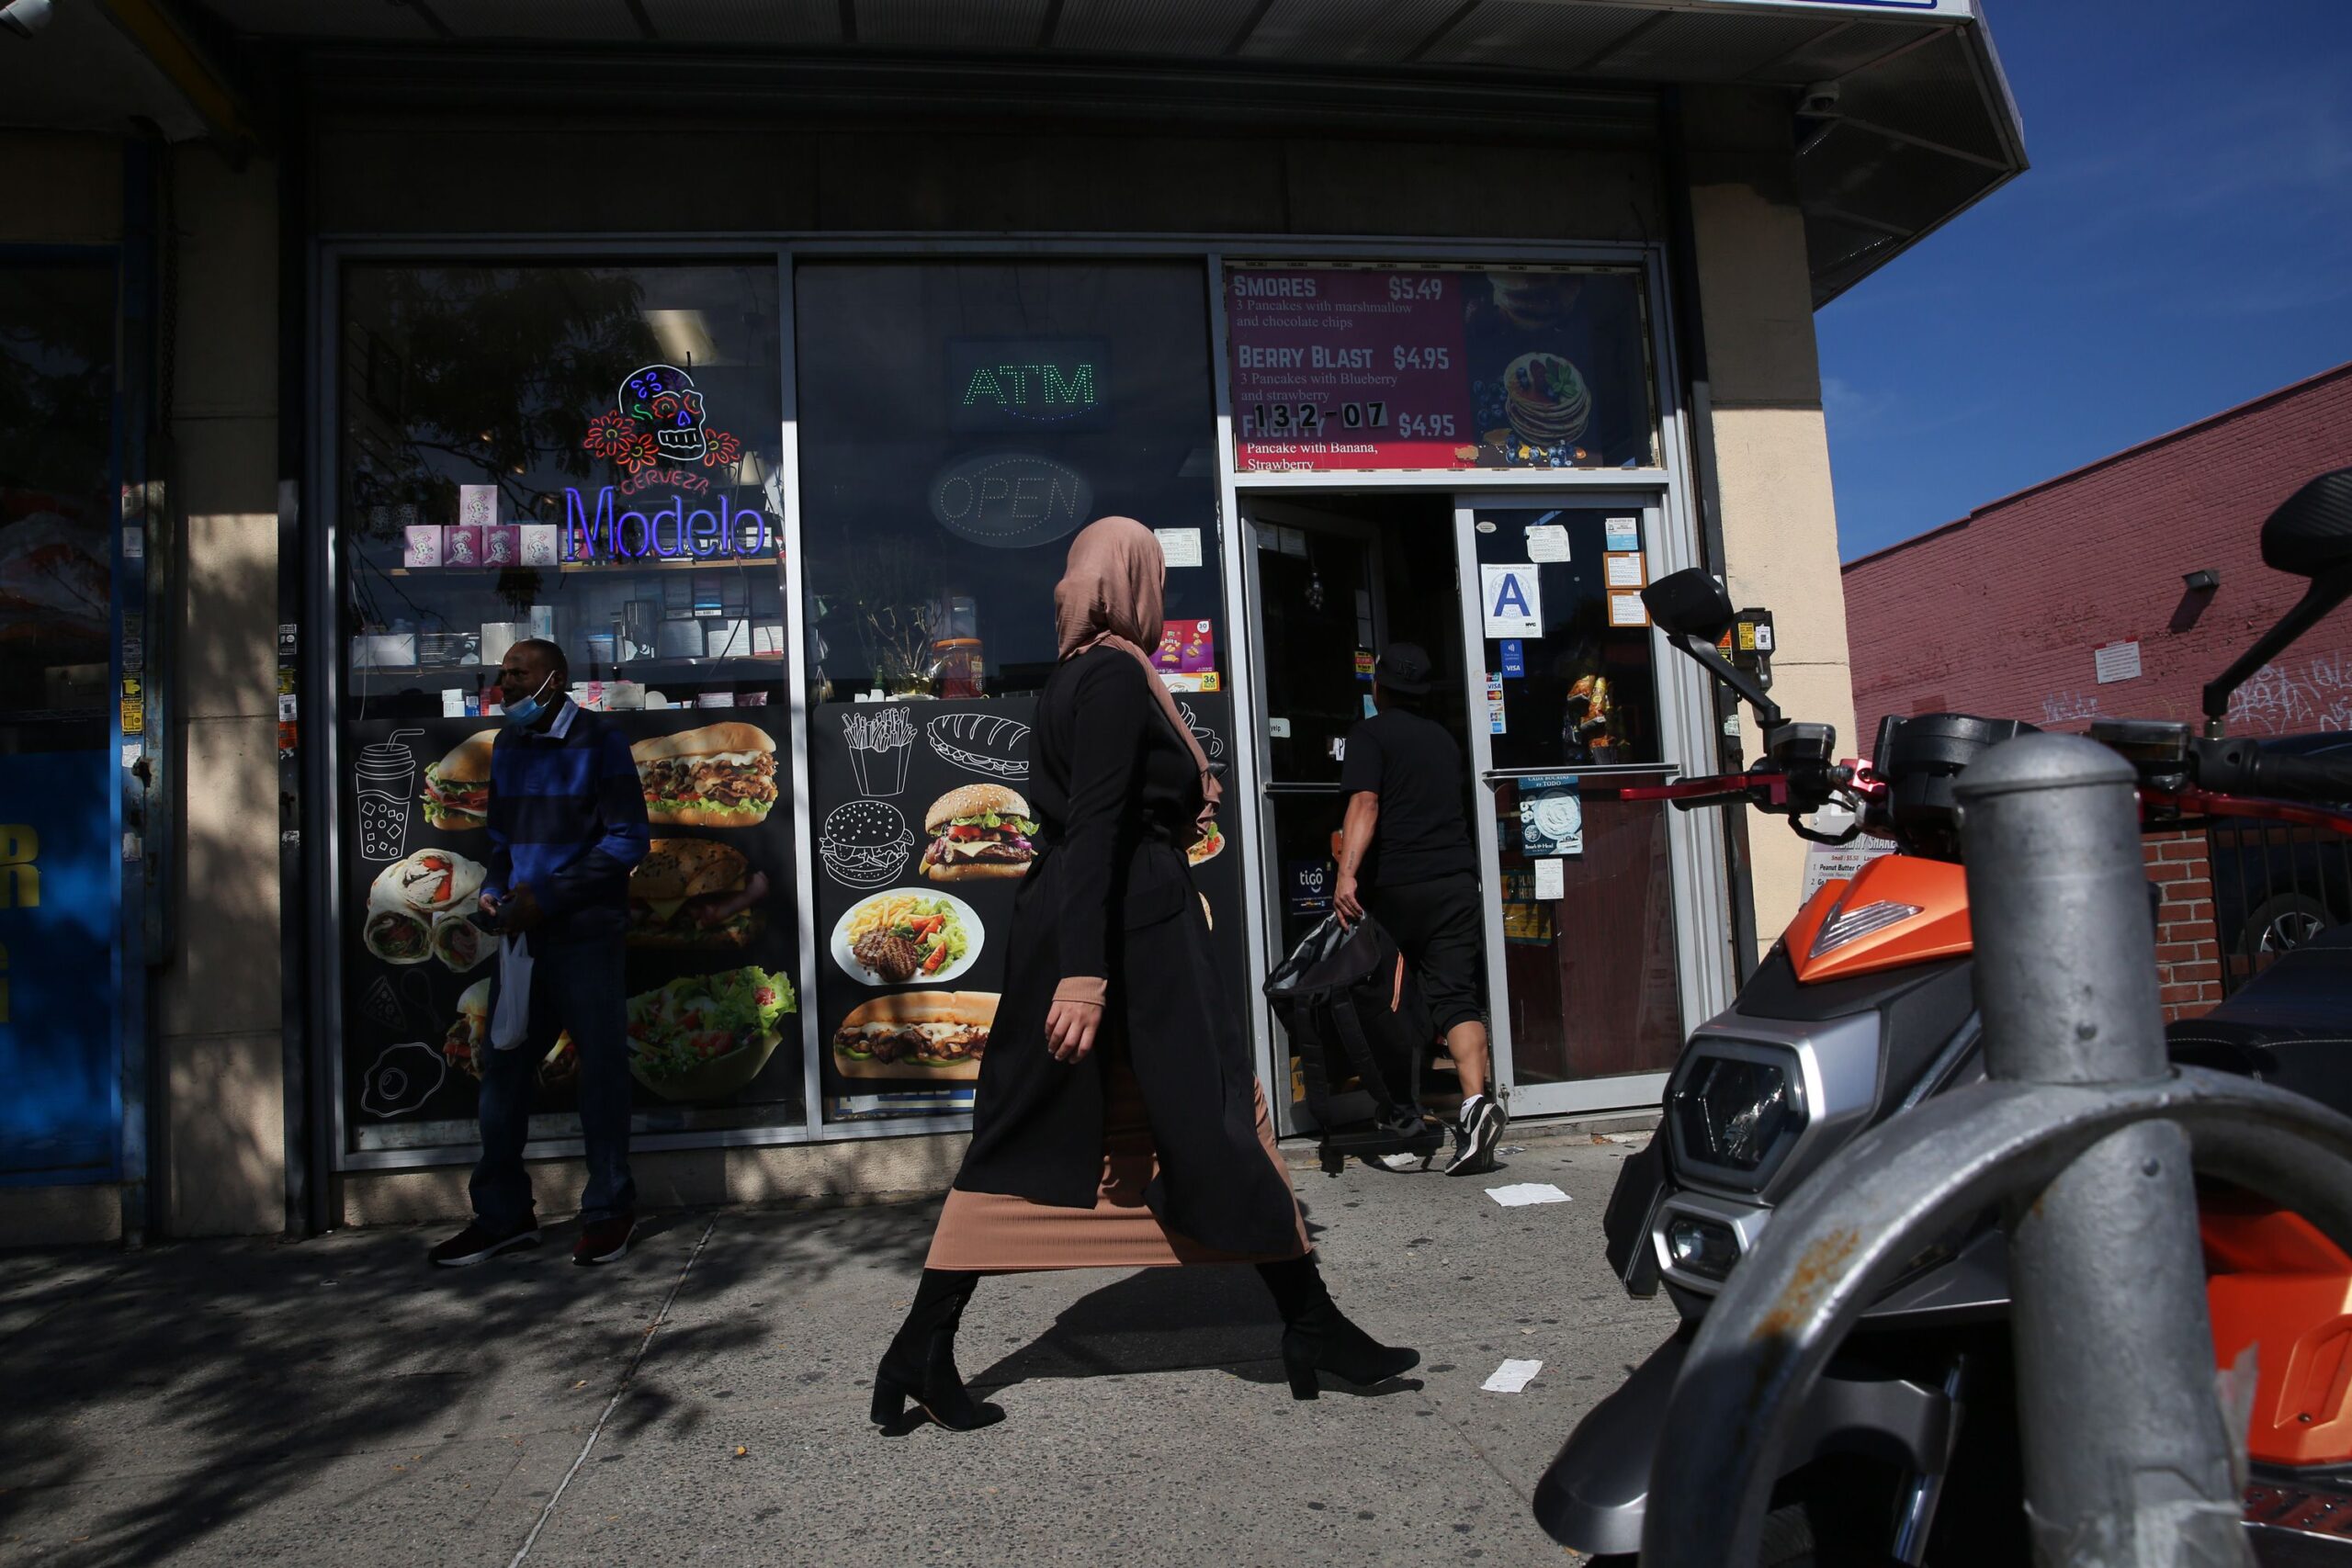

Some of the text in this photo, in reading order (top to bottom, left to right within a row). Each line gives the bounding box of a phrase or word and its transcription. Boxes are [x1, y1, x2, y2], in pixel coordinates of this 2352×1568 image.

[1234, 275, 1442, 300] SMORES $5.49
[1237, 299, 1412, 313] 3 Pancakes with marshmallow
[1237, 315, 1353, 331] and chocolate chips
[1238, 344, 1449, 370] BERRY BLAST $4.95
[963, 365, 1093, 404] ATM
[1240, 372, 1397, 387] 3 Pancakes with Blueberry
[1241, 389, 1330, 403] and strawberry
[1255, 402, 1383, 428] 132-07
[1398, 412, 1455, 438] $4.95
[1247, 442, 1378, 455] Pancake with Banana,
[1248, 458, 1314, 469] Strawberry
[620, 469, 710, 497] CERVEZA
[941, 476, 1080, 518] OPEN
[565, 486, 765, 562] Modelo
[1493, 573, 1532, 616] A
